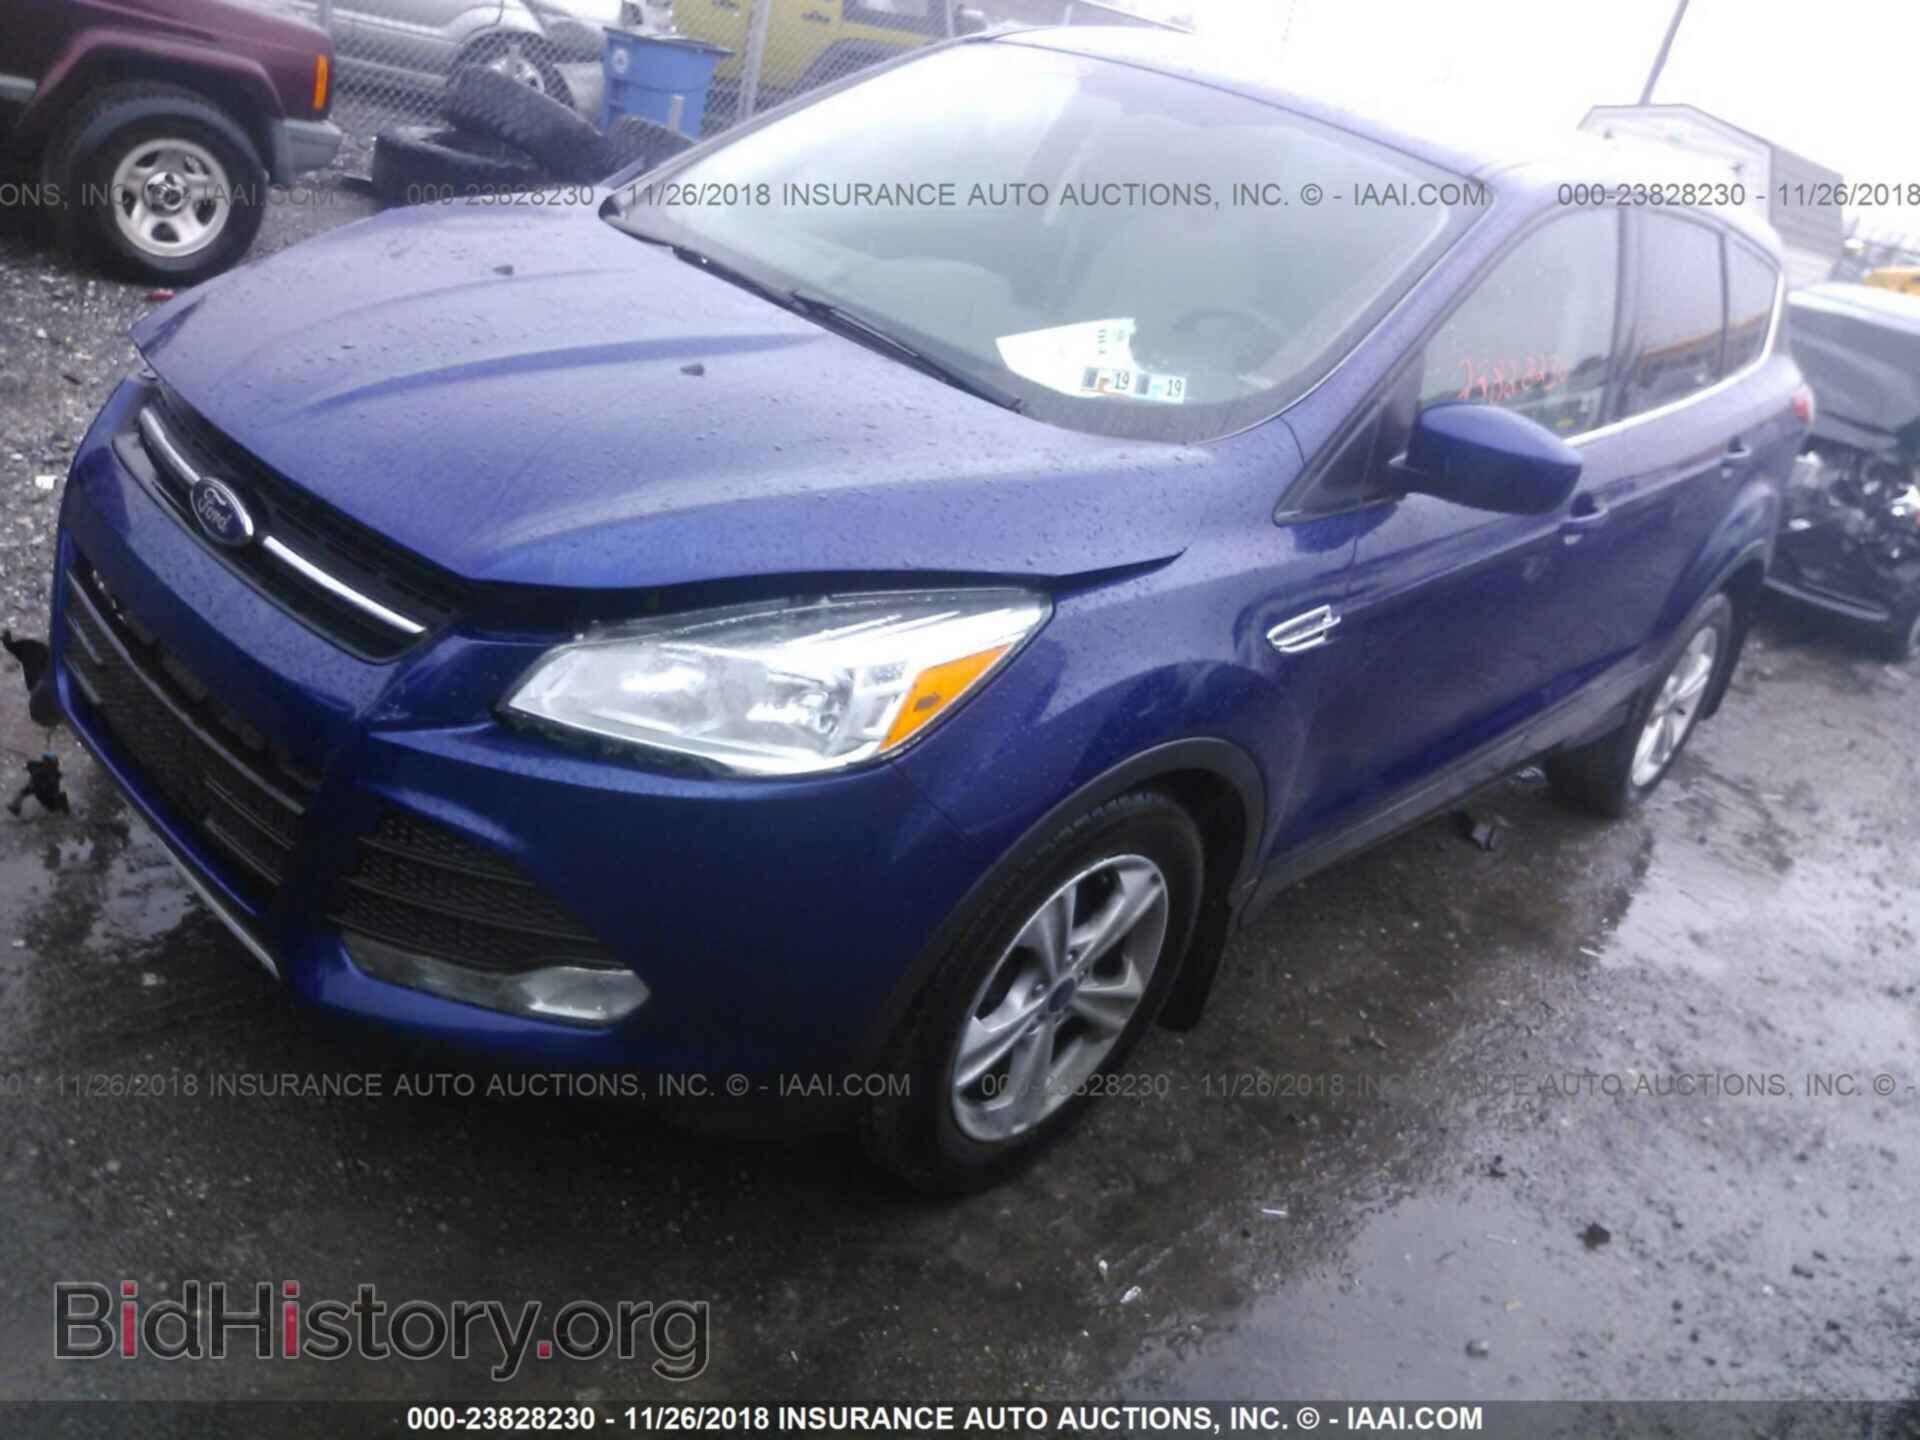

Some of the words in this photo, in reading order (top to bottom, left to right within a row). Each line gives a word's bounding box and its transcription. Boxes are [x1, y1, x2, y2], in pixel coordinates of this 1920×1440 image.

[1114, 371, 1130, 390] 19
[1167, 379, 1182, 398] 19
[198, 487, 232, 533] Ford
